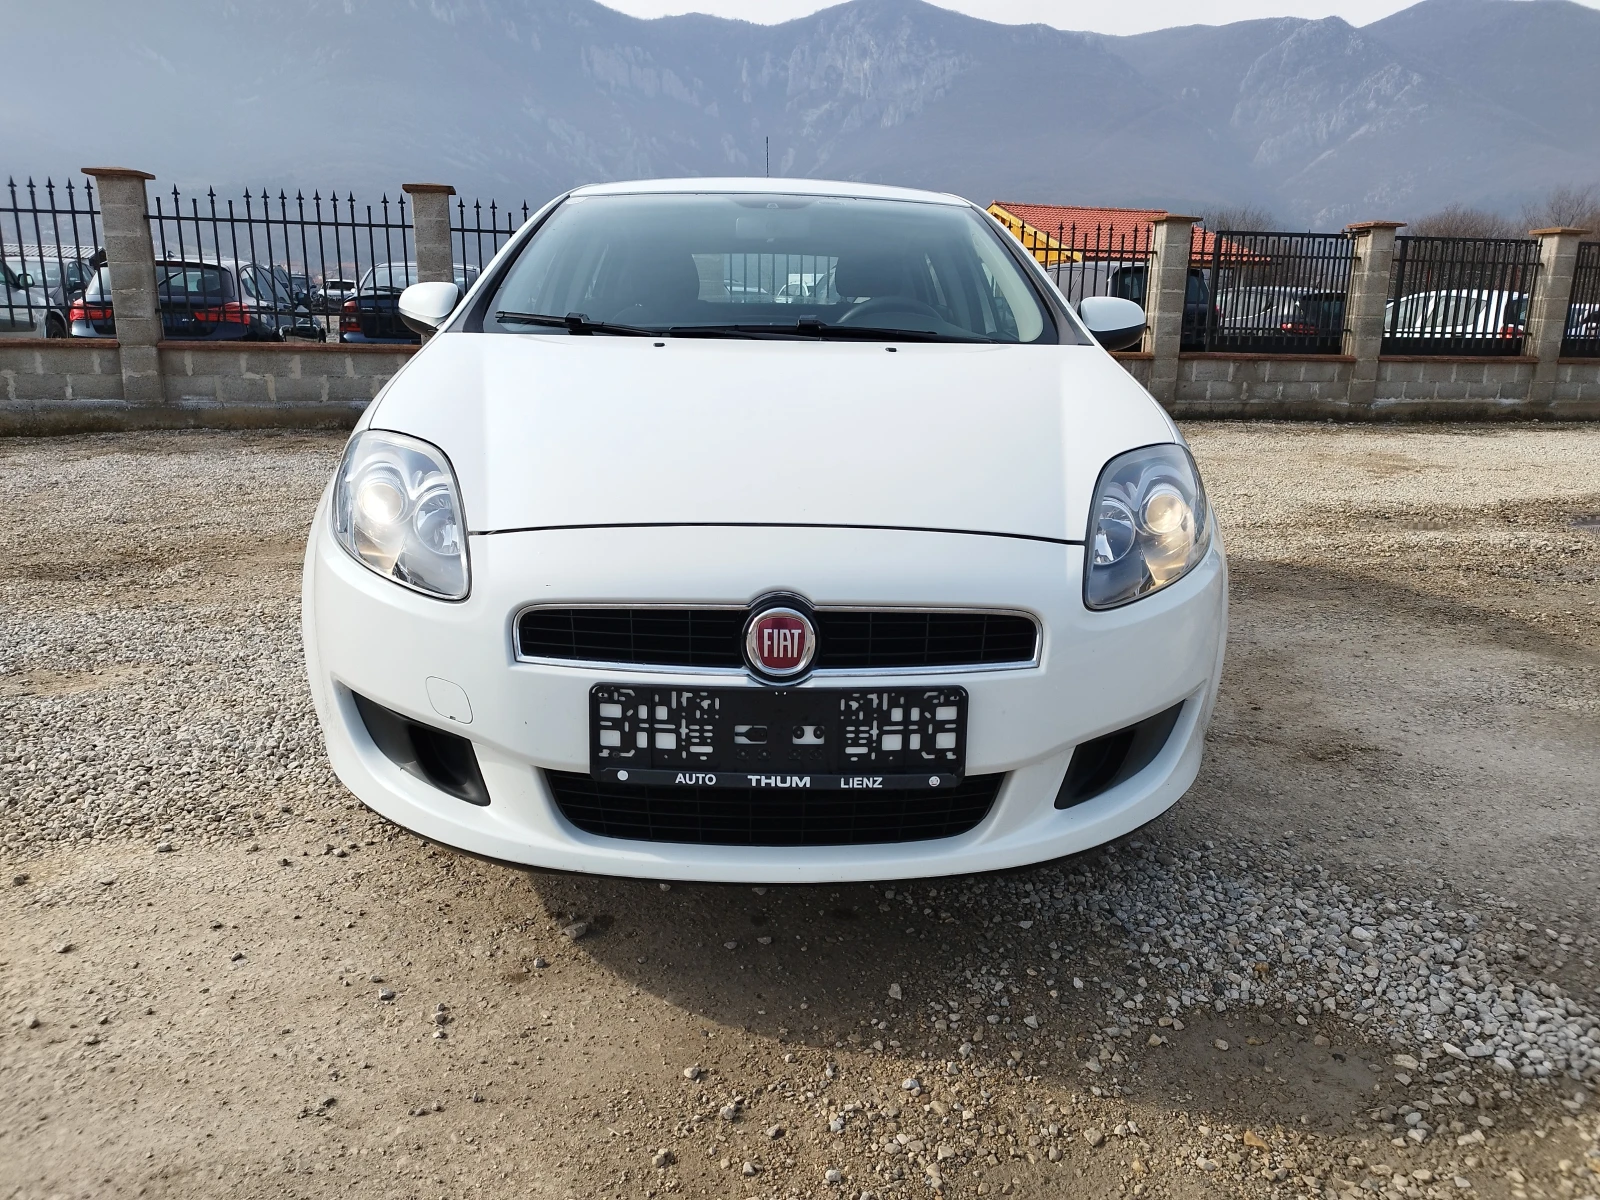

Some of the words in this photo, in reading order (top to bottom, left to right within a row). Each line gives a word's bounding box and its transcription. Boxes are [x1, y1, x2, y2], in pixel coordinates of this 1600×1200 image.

[763, 628, 802, 658] FIAT
[675, 773, 717, 785] AUTO
[747, 775, 811, 788] THUM
[840, 777, 883, 789] LIENZ
